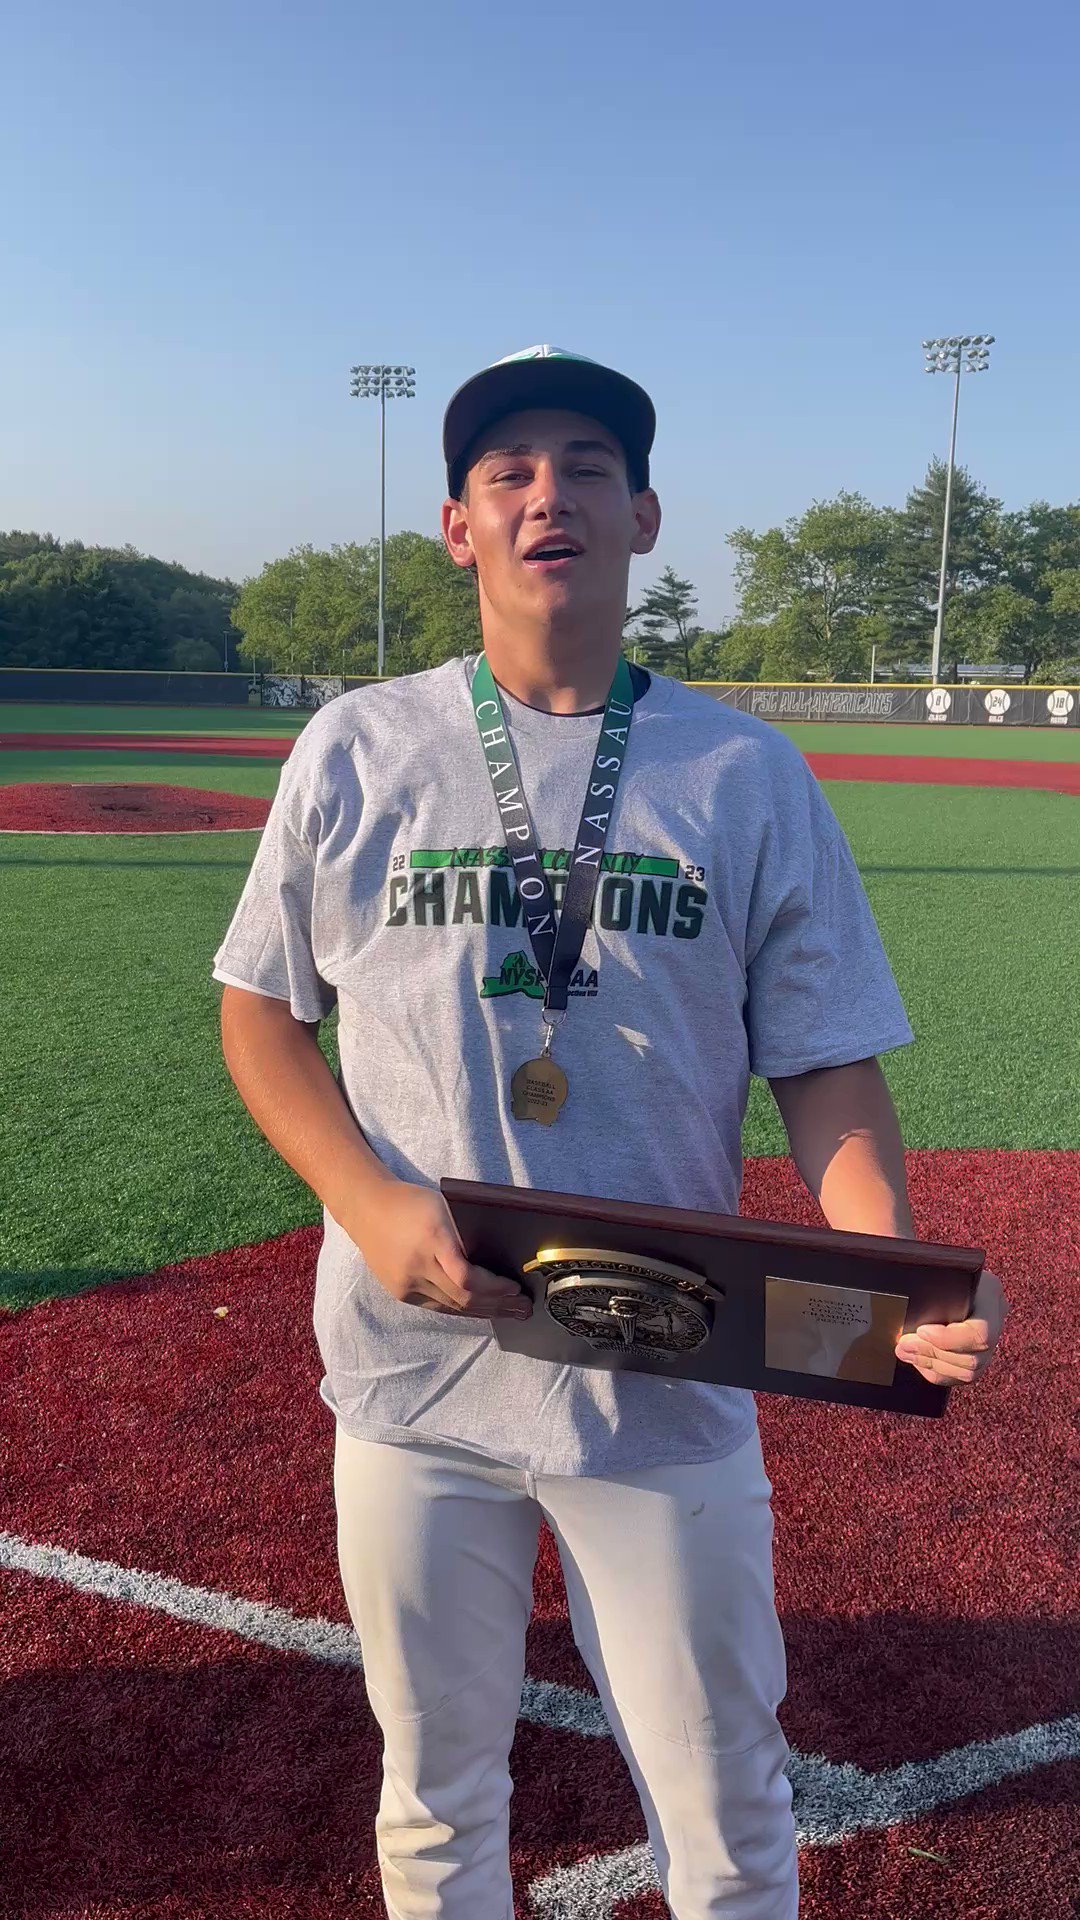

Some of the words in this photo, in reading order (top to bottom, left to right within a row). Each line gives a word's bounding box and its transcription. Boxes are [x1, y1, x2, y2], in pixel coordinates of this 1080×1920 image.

[475, 700, 554, 936] CHAMPION
[574, 697, 632, 869] NASSAU
[392, 854, 406, 871] 22
[684, 865, 705, 882] 23
